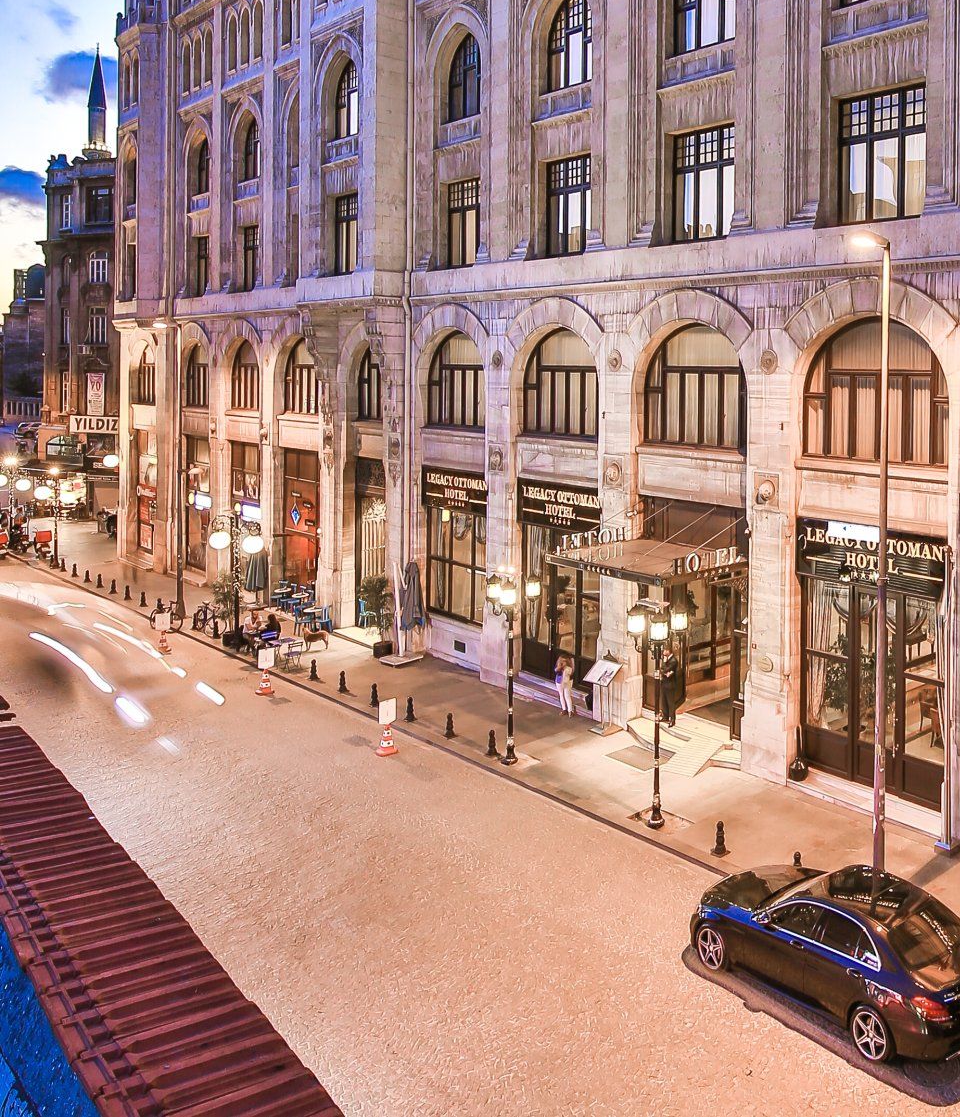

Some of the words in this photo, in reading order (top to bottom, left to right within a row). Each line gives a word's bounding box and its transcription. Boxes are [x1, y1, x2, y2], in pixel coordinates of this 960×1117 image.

[91, 381, 101, 391] 70
[75, 417, 118, 431] YILDIZ
[426, 472, 453, 486] LEGACY
[453, 476, 488, 491] OTTOMAN
[444, 488, 469, 502] HOTEL
[522, 485, 556, 502] LEGACY
[556, 491, 601, 509] OTTOMAN
[544, 503, 576, 519] HOTEL
[867, 537, 945, 563] OTOMAN
[671, 546, 742, 576] HOTEL
[844, 551, 901, 574] HOTL
